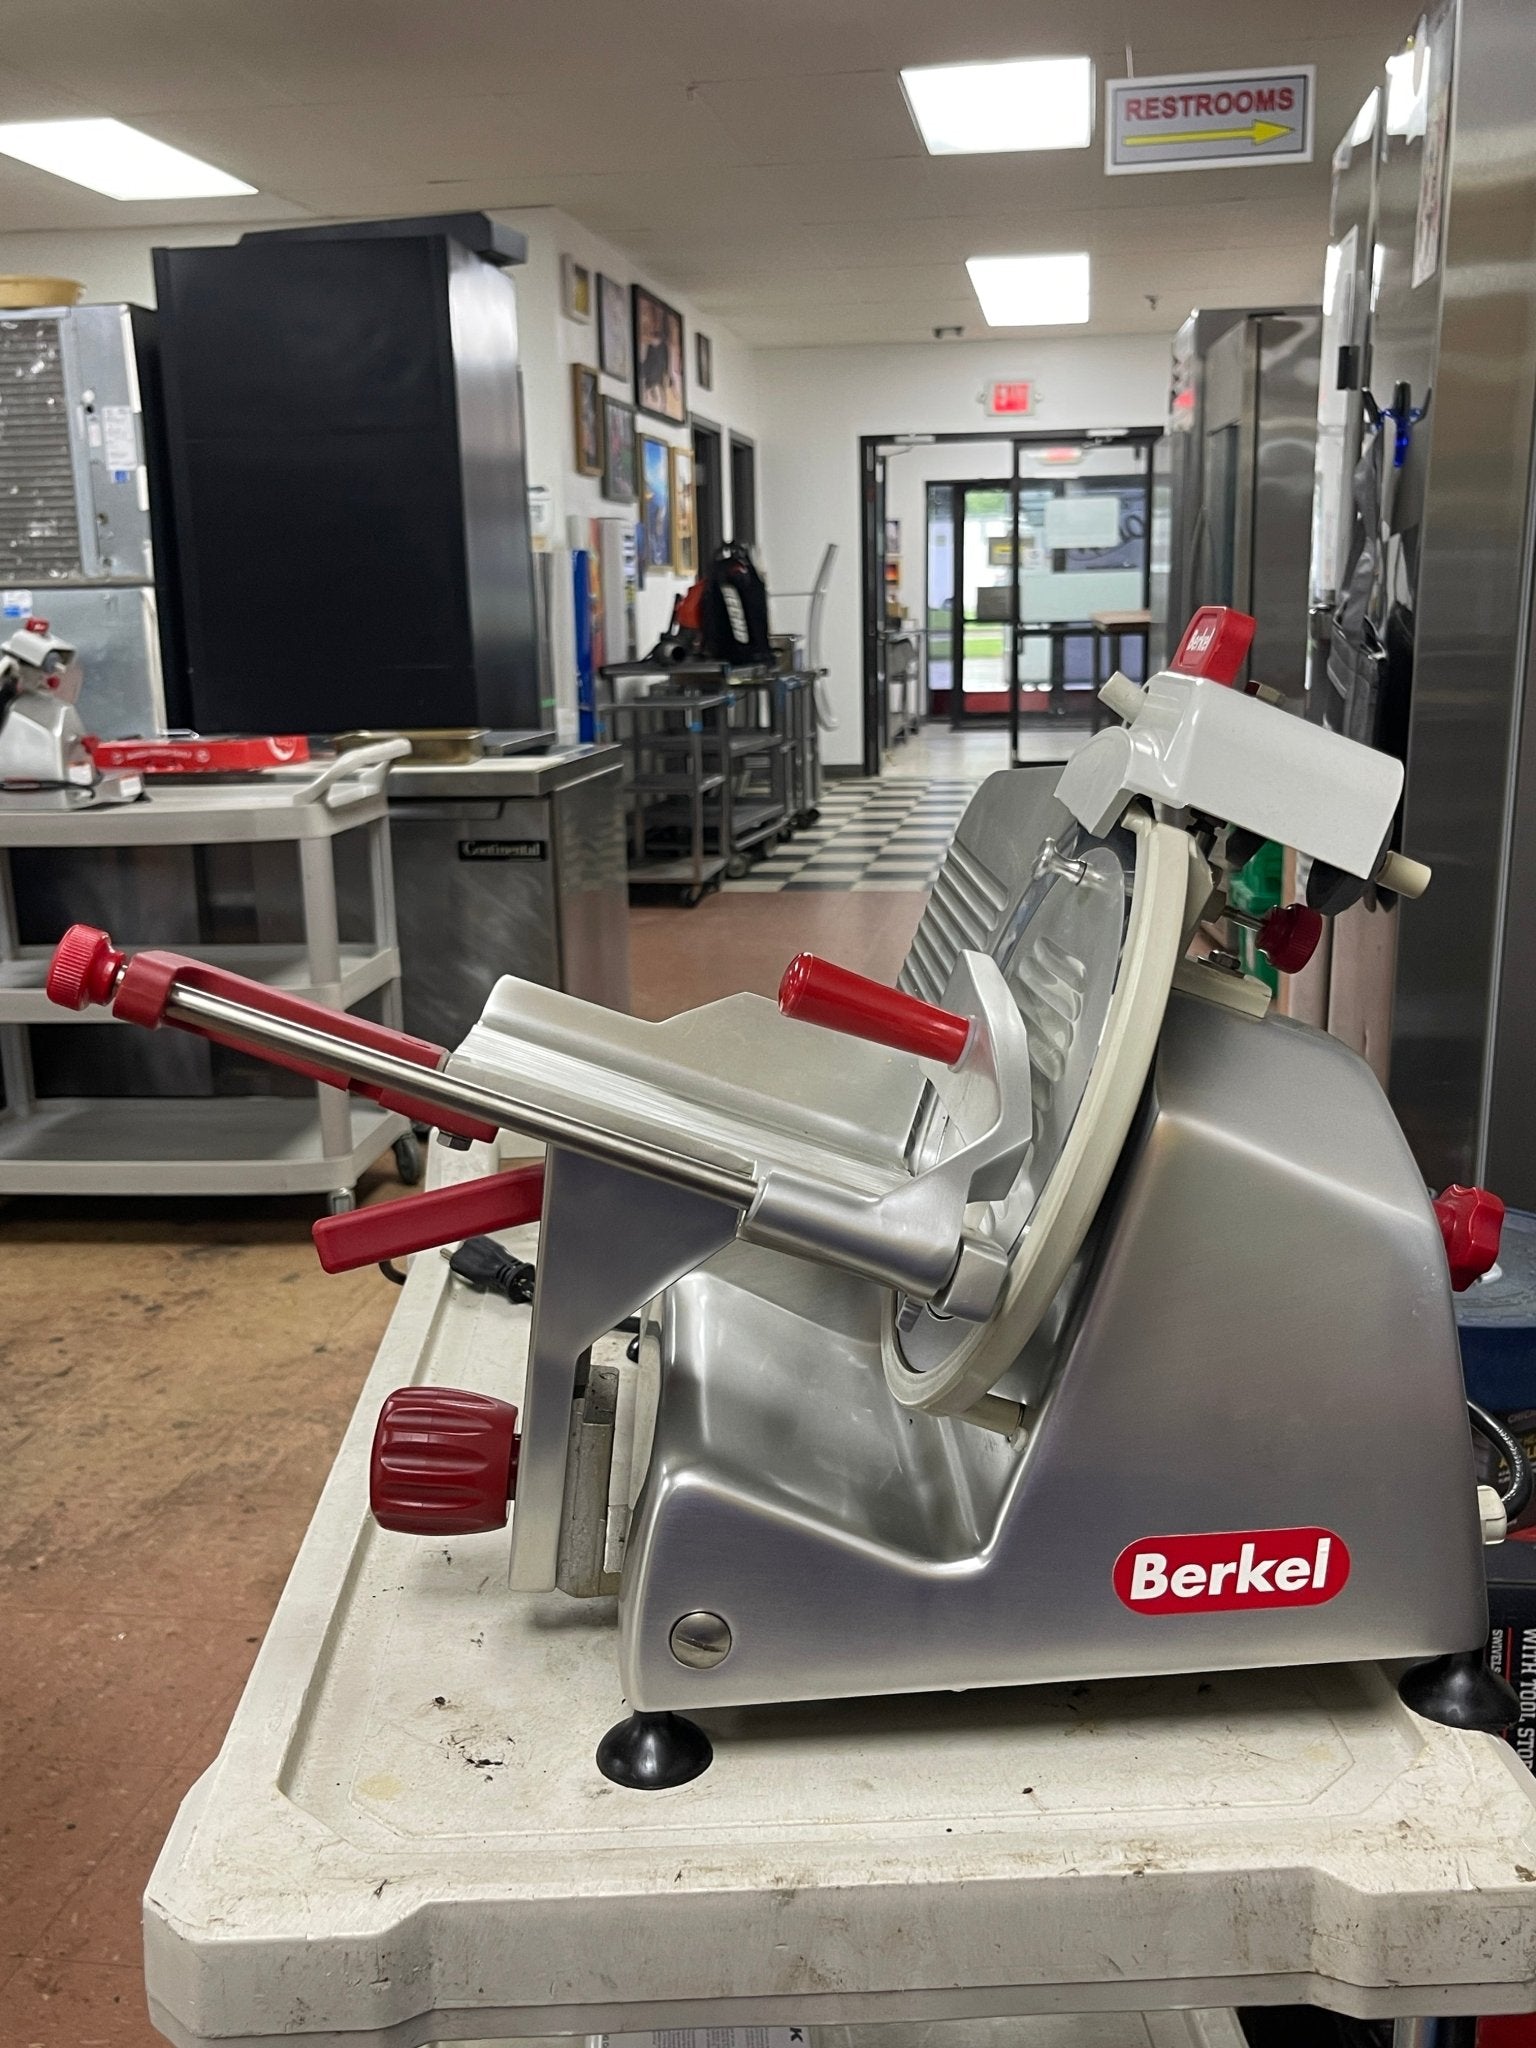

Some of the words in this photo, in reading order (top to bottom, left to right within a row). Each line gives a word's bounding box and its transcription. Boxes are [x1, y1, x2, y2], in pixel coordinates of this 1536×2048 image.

[1125, 87, 1295, 121] RESTROOMS
[1186, 627, 1216, 652] Berkel
[1130, 1537, 1331, 1600] Berkel
[1490, 1628, 1504, 1674] SWIVELS
[1521, 1628, 1536, 1674] WITH
[1518, 1682, 1536, 1722] TOOL
